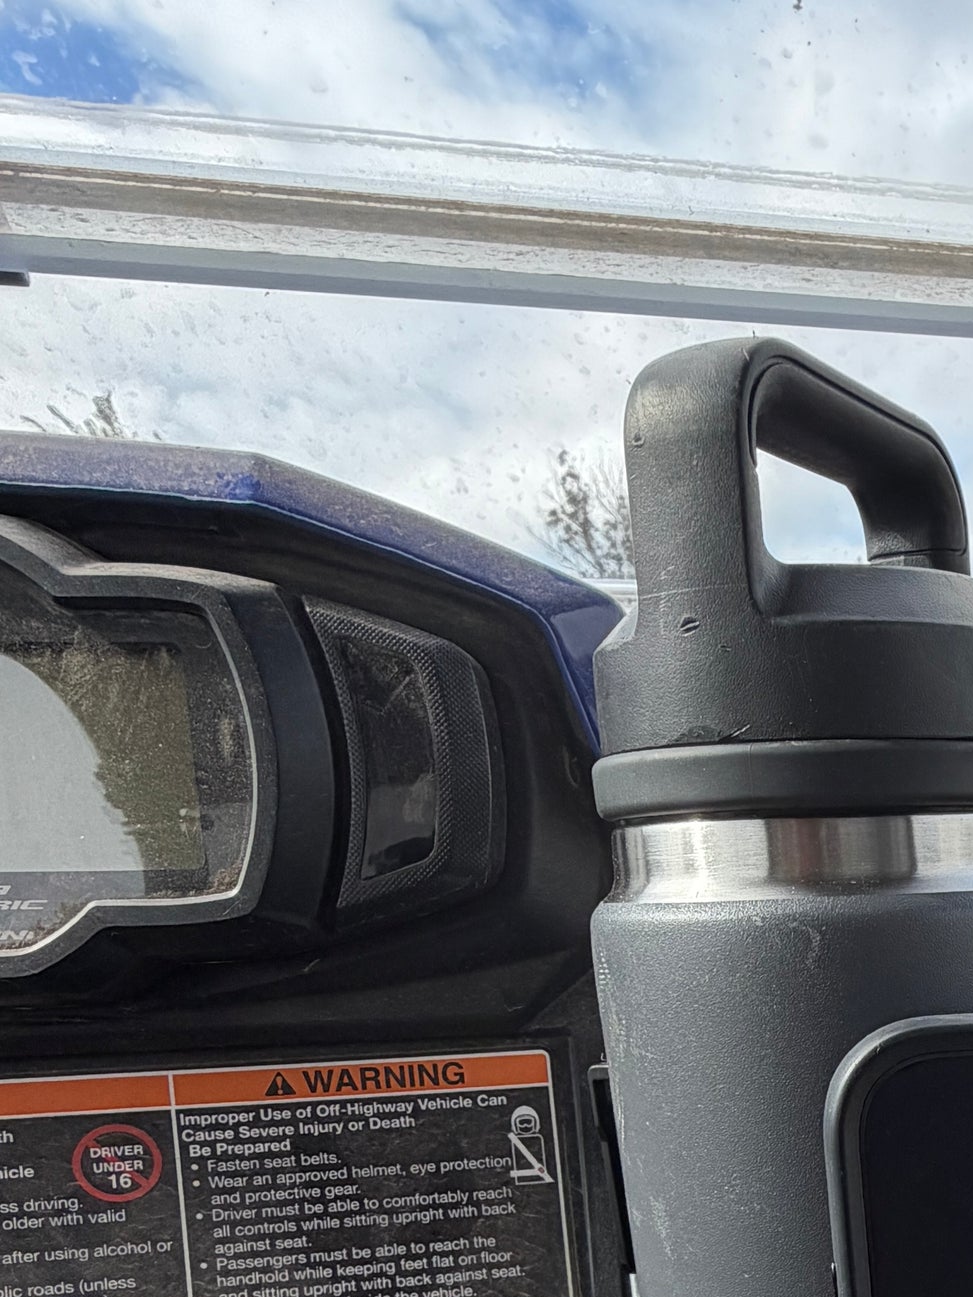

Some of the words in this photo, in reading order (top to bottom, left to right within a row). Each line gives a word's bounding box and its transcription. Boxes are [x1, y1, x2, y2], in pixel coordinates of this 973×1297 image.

[303, 1062, 465, 1093] WARNING
[179, 1111, 255, 1127] Improper
[259, 1108, 291, 1120] Use
[295, 1105, 311, 1118] of
[315, 1101, 414, 1117] Off-Highway
[417, 1095, 472, 1110] Vehicle
[476, 1094, 507, 1107] Can
[181, 1128, 234, 1142] Cause
[238, 1125, 294, 1138] Severe
[298, 1120, 344, 1136] Injury
[347, 1120, 365, 1131] or
[368, 1115, 415, 1129] Death
[90, 1145, 143, 1158] DRIVER
[188, 1144, 211, 1157] Be
[215, 1138, 291, 1156] Prepared
[93, 1160, 143, 1174] UNDER
[206, 1159, 259, 1172] Fasten
[263, 1154, 296, 1168] seat
[299, 1151, 341, 1165] belts.
[207, 1175, 248, 1188] Wear
[252, 1174, 272, 1185] an
[275, 1166, 348, 1185] approved
[351, 1163, 406, 1178] helmet,
[409, 1162, 436, 1176] eye
[439, 1155, 511, 1174] protection
[107, 1173, 132, 1189] 16
[22, 1197, 83, 1211] driving.
[210, 1191, 240, 1205] and
[244, 1187, 321, 1205] protective
[324, 1184, 361, 1199] gear.
[212, 1208, 257, 1221] Driver
[261, 1202, 300, 1217] must
[303, 1201, 324, 1214] be
[327, 1198, 359, 1212] able
[363, 1197, 379, 1209] to
[382, 1189, 469, 1208] comfortably
[472, 1185, 512, 1200] reach
[1, 1215, 44, 1230] older
[48, 1212, 83, 1226] with
[87, 1208, 126, 1223] valid
[212, 1224, 230, 1238] all
[234, 1219, 297, 1236] controls
[300, 1216, 340, 1230] while
[342, 1212, 388, 1227] sitting
[392, 1207, 444, 1225] upright
[447, 1204, 478, 1218] with
[481, 1201, 516, 1215] back
[2, 1250, 40, 1264] after
[44, 1247, 88, 1261] using
[93, 1240, 151, 1257] alcohol
[156, 1240, 173, 1252] or
[214, 1237, 271, 1256] against
[274, 1235, 312, 1249] seat.
[216, 1253, 307, 1271] Passengers
[309, 1247, 348, 1262] must
[351, 1246, 371, 1259] be
[374, 1242, 407, 1257] able
[409, 1241, 426, 1253] to
[428, 1237, 469, 1252] reach
[472, 1235, 496, 1248] the
[216, 1268, 289, 1287] handhold
[292, 1265, 332, 1280] while
[336, 1261, 395, 1277] keeping
[399, 1257, 428, 1270] feet
[430, 1254, 454, 1267] flat
[457, 1254, 477, 1265] on
[479, 1250, 513, 1263] floor
[27, 1281, 74, 1296] roads
[78, 1277, 136, 1295] (unless
[303, 1279, 357, 1297] upright
[360, 1276, 392, 1290] with
[395, 1272, 432, 1287] back
[435, 1267, 488, 1285] against
[490, 1264, 526, 1278] seat.
